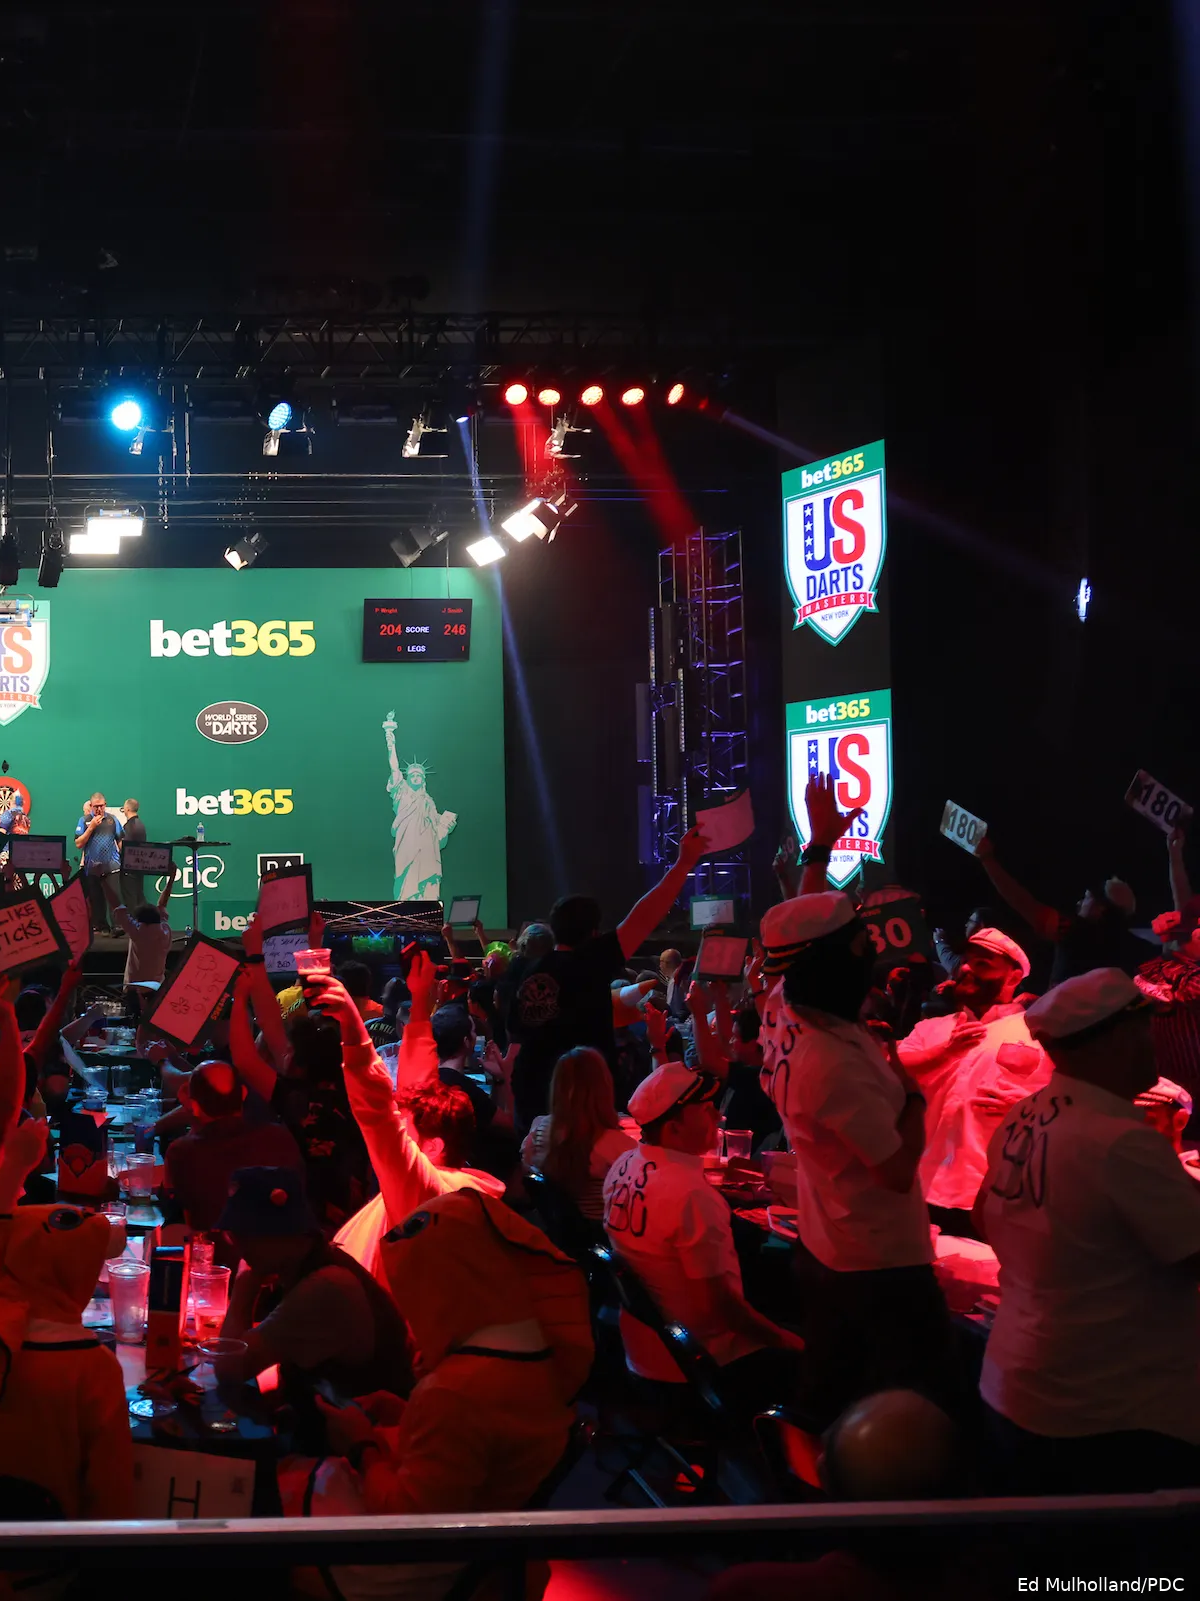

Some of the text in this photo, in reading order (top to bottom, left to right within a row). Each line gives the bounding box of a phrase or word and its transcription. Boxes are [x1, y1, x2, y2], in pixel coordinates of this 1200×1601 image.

[801, 452, 864, 489] bet365
[803, 489, 866, 571] US
[806, 563, 864, 601] DARTS
[805, 593, 865, 615] MASTERS
[820, 609, 850, 622] NEW YORK
[150, 619, 316, 657] bet365
[379, 624, 402, 635] 204
[443, 624, 467, 635] 246
[805, 698, 871, 724] bet365
[212, 722, 257, 735] DARTS
[176, 788, 294, 815] bet365
[1141, 783, 1181, 826] 180
[948, 808, 977, 845] 180
